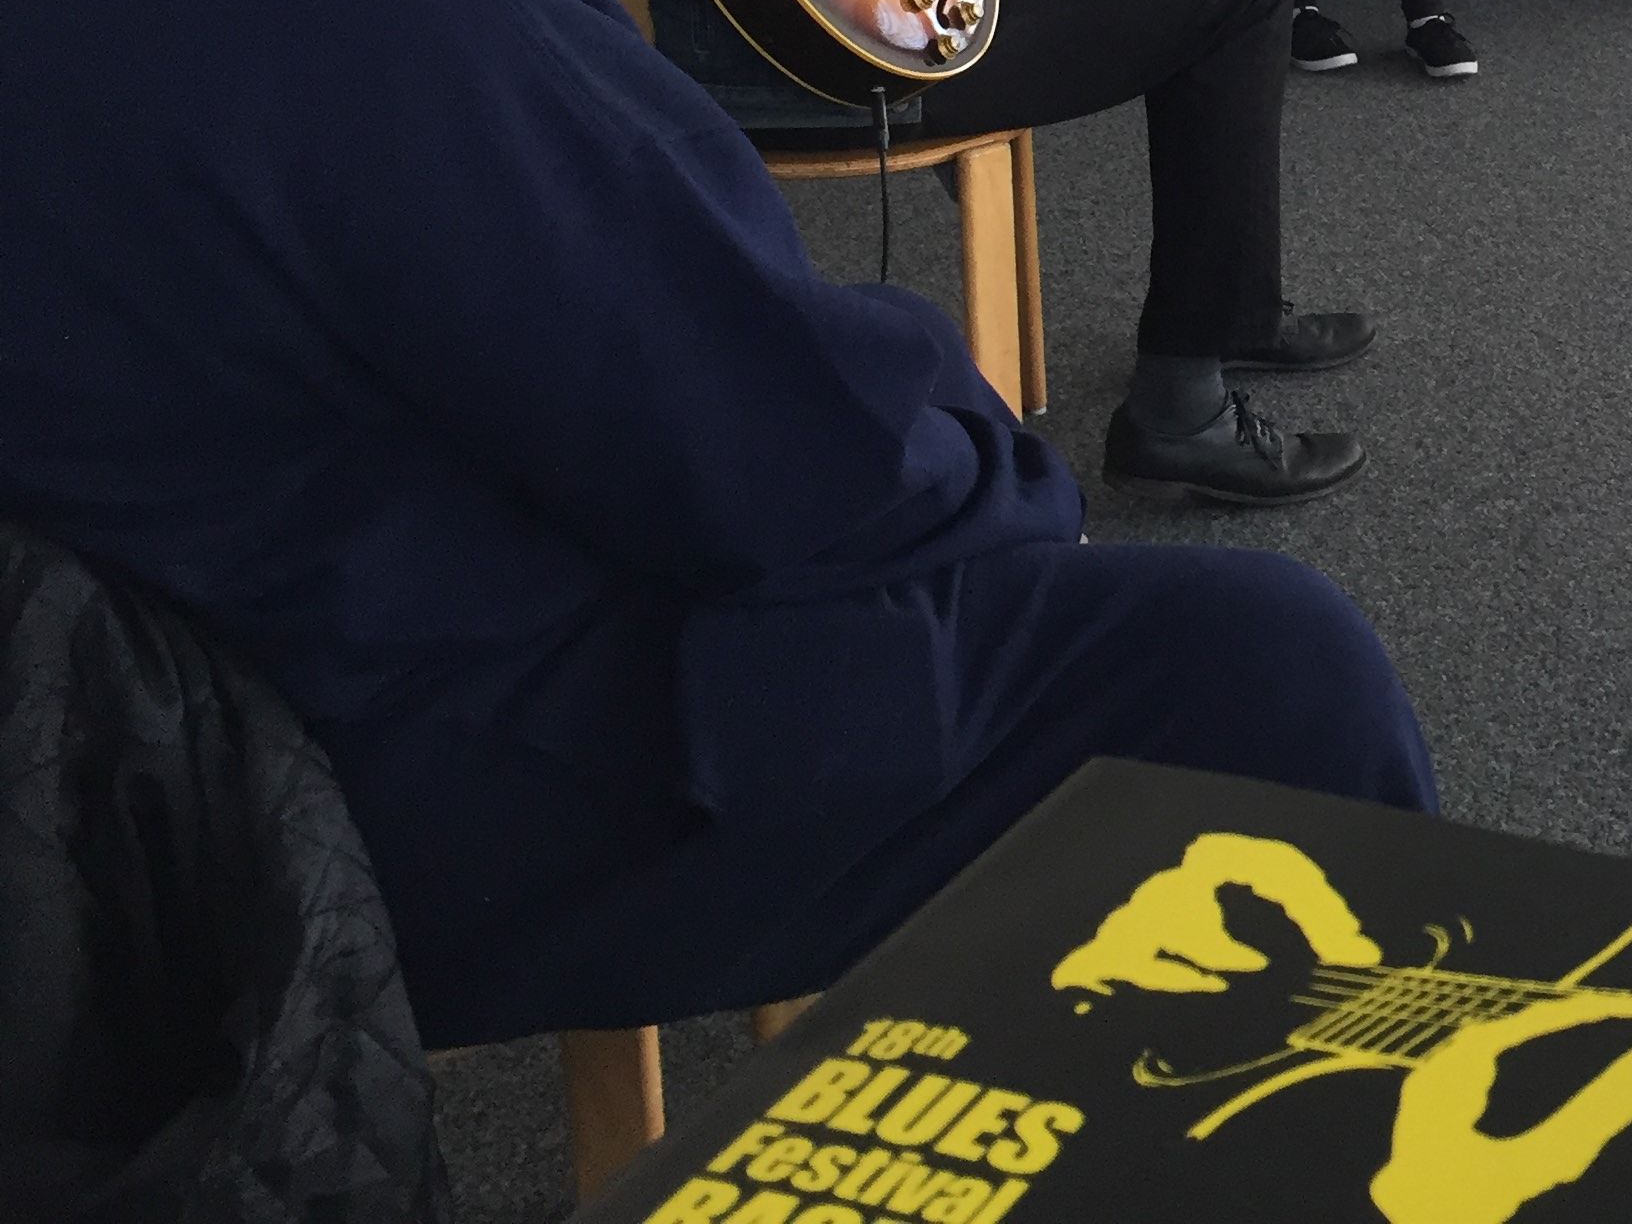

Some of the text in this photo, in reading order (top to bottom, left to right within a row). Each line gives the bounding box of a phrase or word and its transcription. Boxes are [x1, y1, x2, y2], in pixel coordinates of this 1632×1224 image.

[845, 1016, 971, 1061] 18th
[766, 1056, 1086, 1175] BLUES
[706, 1120, 1031, 1224] Festival
